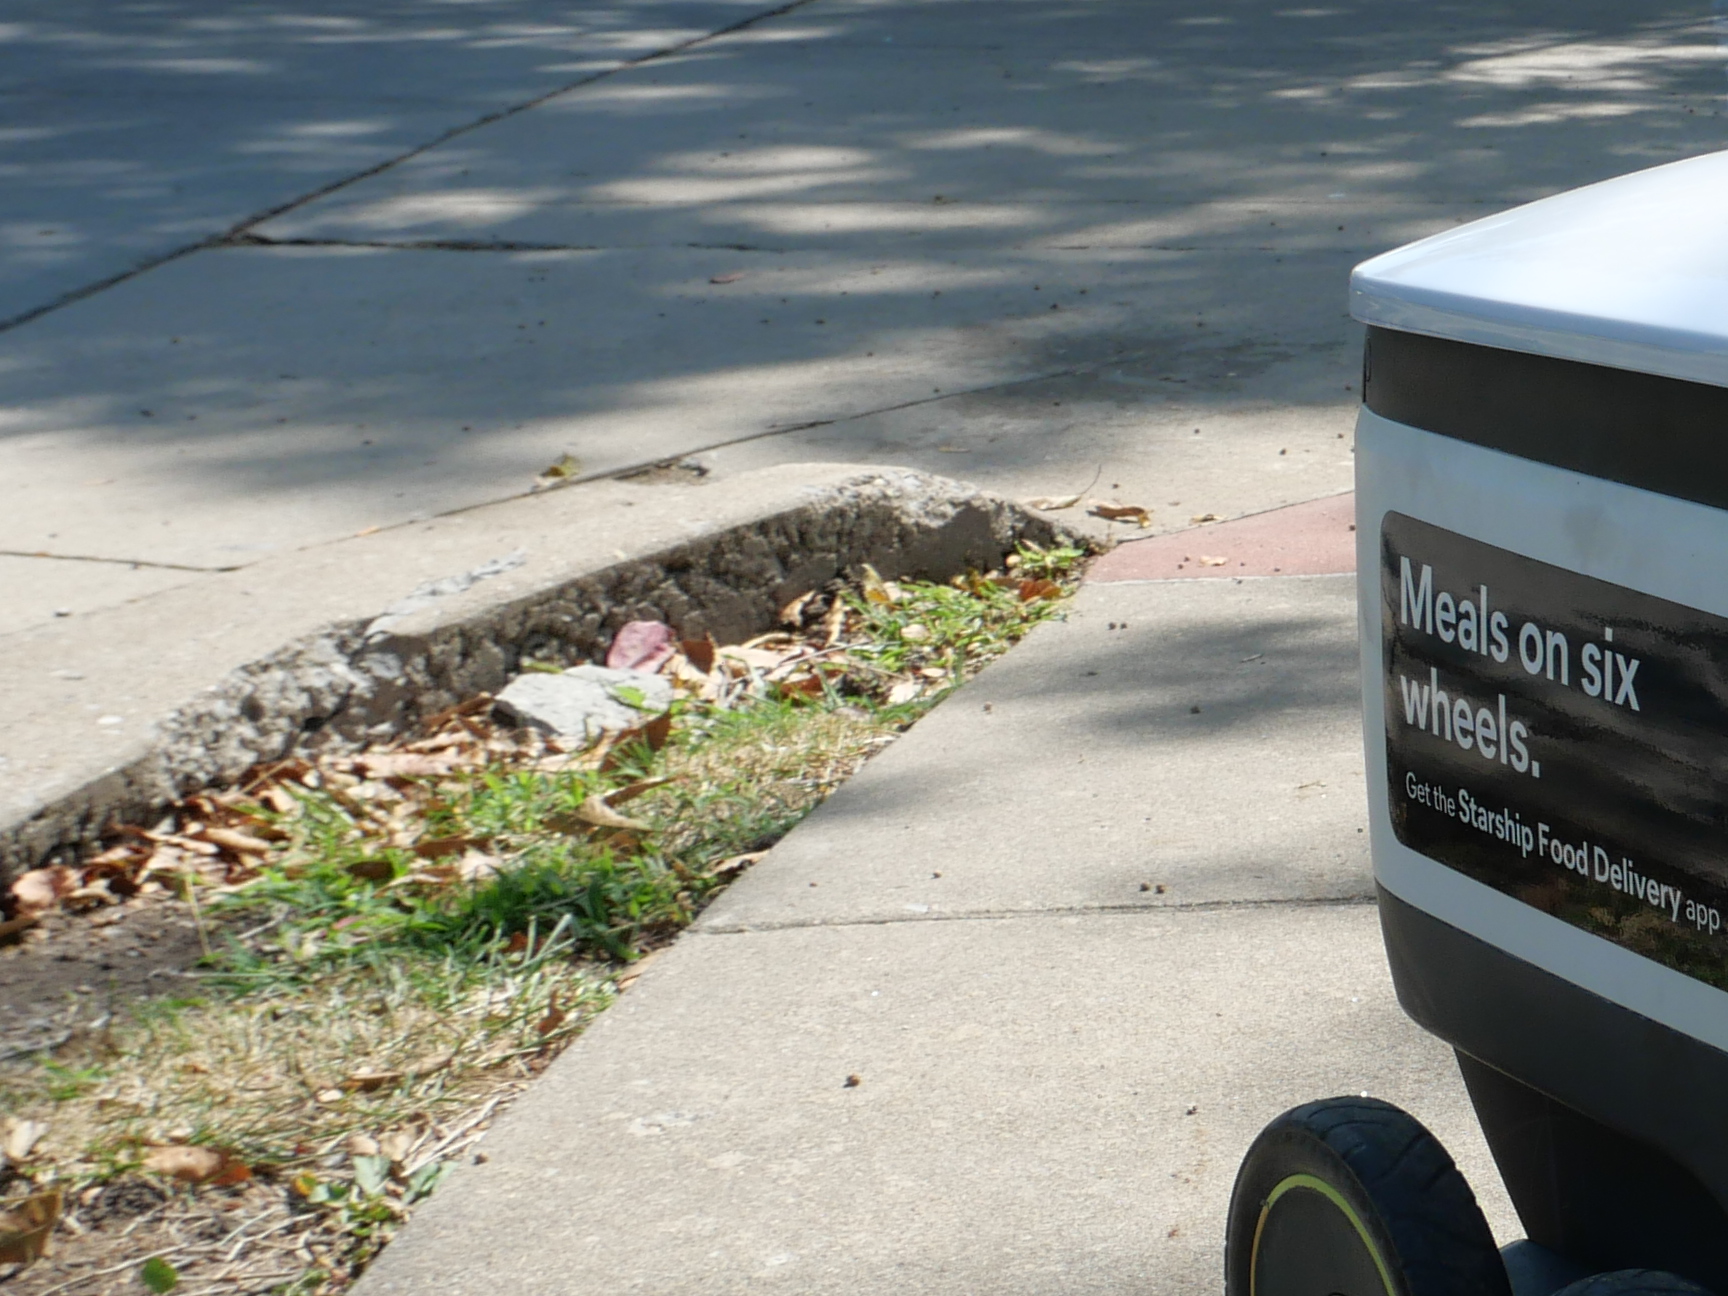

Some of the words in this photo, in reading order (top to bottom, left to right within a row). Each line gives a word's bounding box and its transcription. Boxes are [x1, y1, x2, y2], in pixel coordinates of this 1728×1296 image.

[1400, 555, 1510, 664] Meals
[1518, 622, 1570, 687] on
[1580, 626, 1642, 712] six
[1399, 666, 1541, 779] wheels.
[1405, 771, 1431, 807] Get
[1433, 789, 1456, 818] the
[1457, 788, 1535, 859] Starship
[1537, 822, 1589, 877] Food
[1593, 845, 1682, 923] Delivery
[1686, 898, 1722, 935] app
